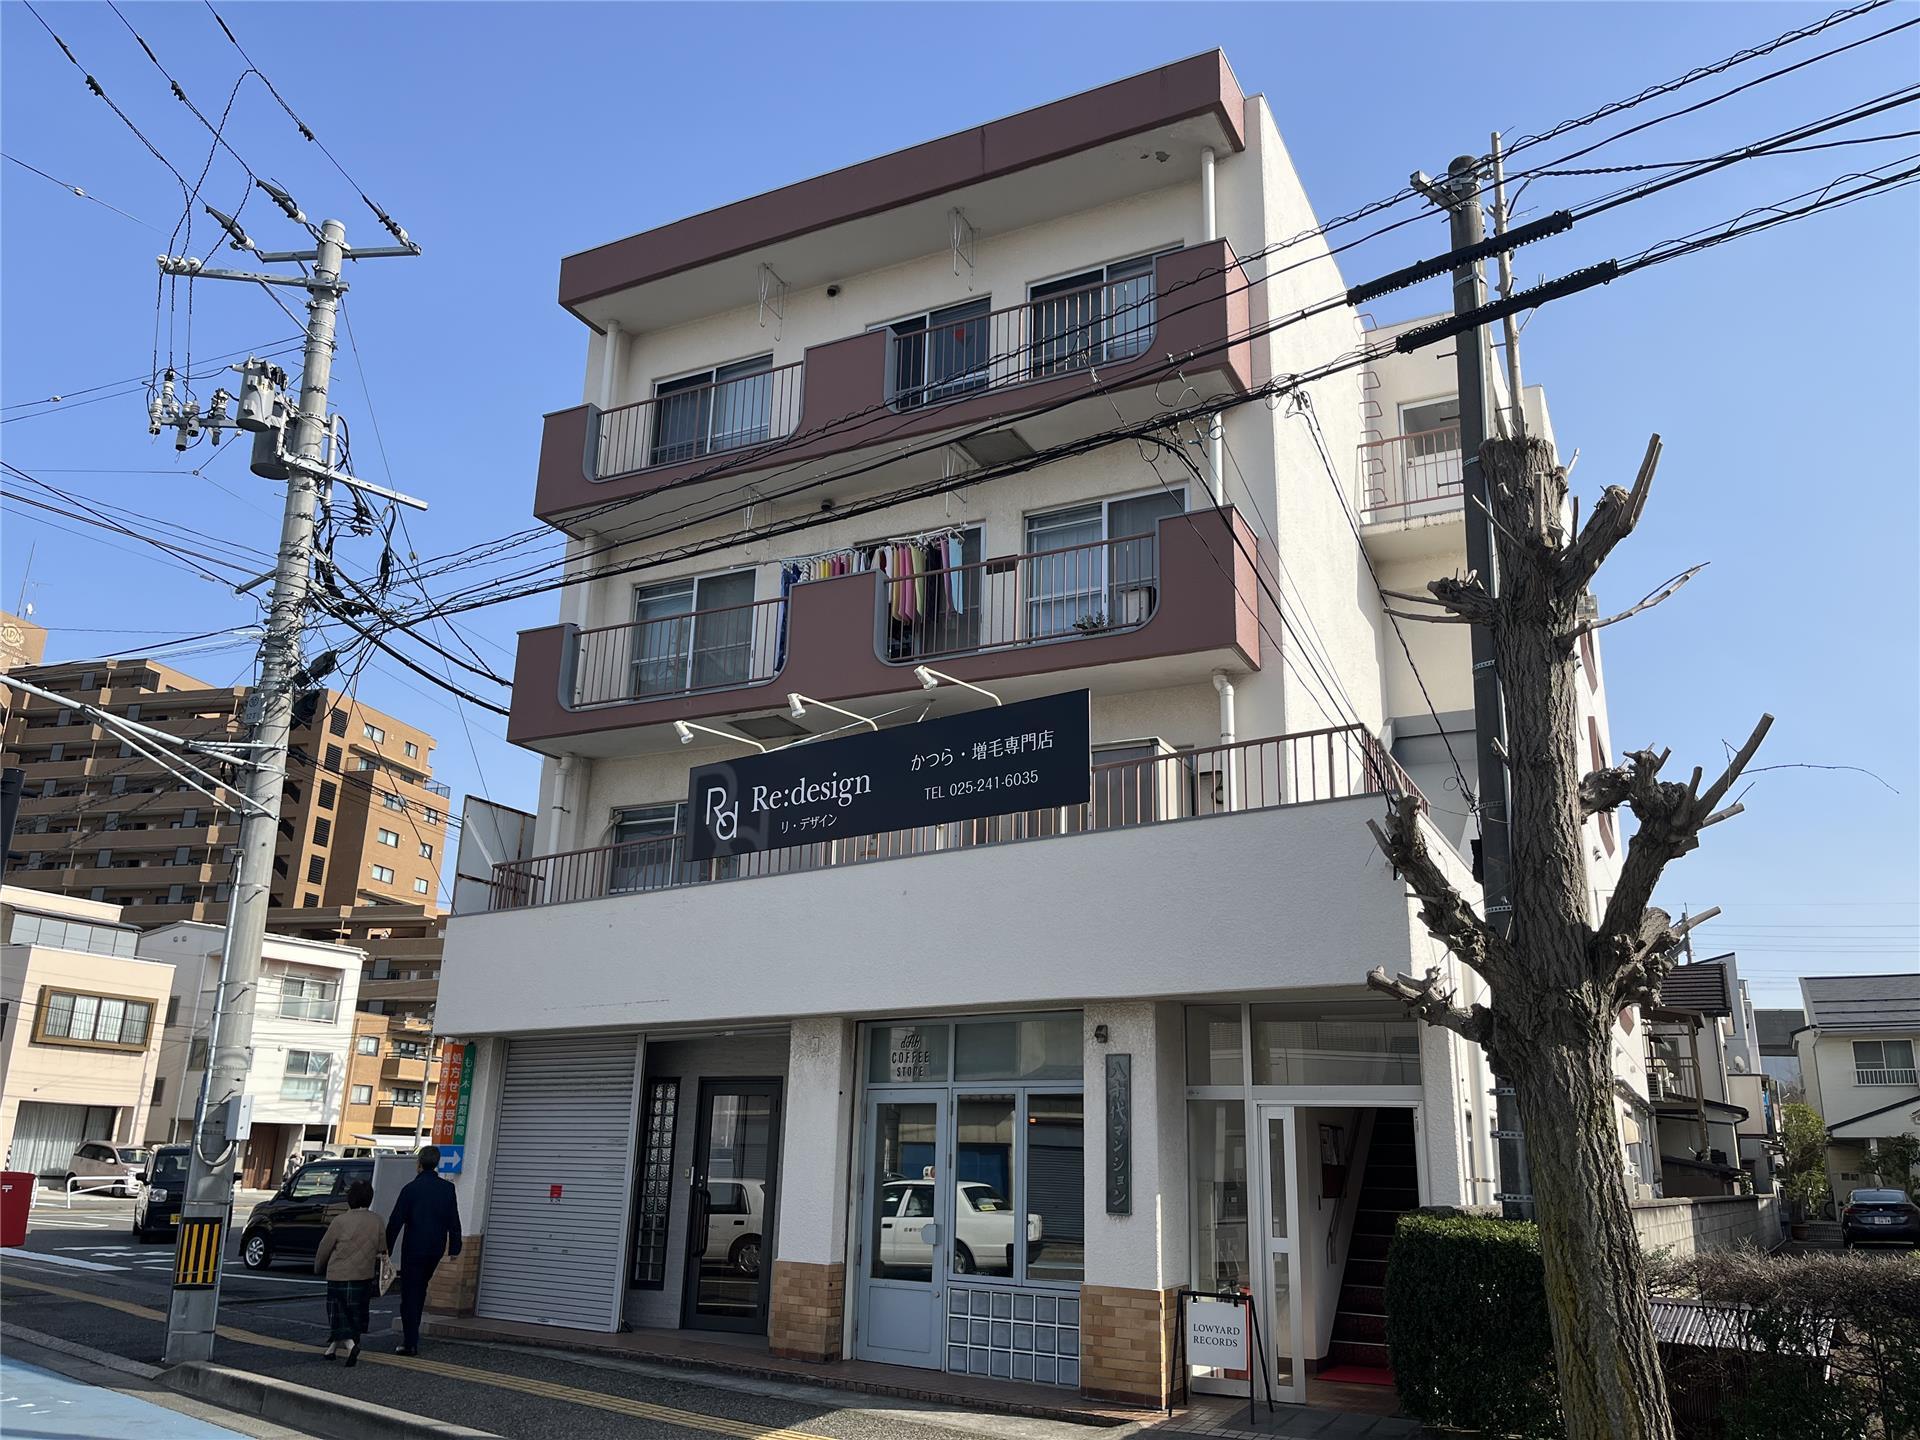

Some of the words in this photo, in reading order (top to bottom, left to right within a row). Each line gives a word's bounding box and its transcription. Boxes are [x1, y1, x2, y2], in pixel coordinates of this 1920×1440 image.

[911, 729, 1055, 772] かつら・増毛専門店
[751, 771, 872, 808] Re:design
[924, 785, 945, 801] TEL
[949, 769, 1039, 797] 025-241-6035
[780, 813, 838, 834] リ・デザイン
[891, 1050, 929, 1064] COFFEE
[896, 1065, 924, 1077] STORE
[443, 1052, 463, 1136] 処方せん受付
[1110, 1061, 1127, 1206] 八千代マンション
[1193, 1324, 1240, 1335] LOWYARD
[1193, 1336, 1238, 1347] RECORDS
